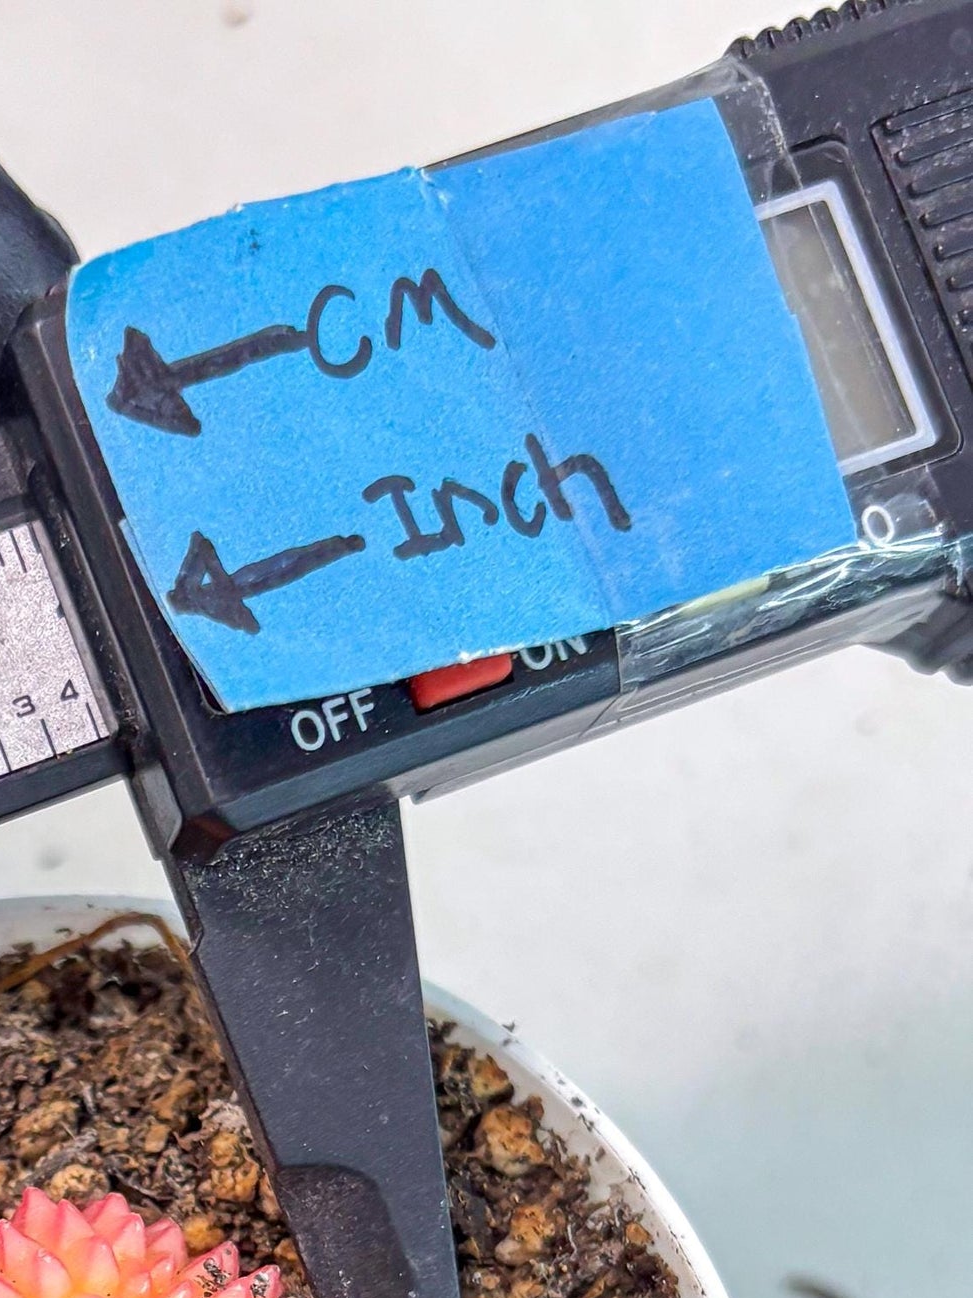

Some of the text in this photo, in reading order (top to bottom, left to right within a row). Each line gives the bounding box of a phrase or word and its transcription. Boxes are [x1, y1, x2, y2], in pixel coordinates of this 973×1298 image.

[362, 432, 631, 560] Inch
[12, 695, 35, 717] 3
[60, 679, 79, 702] 4
[291, 687, 375, 751] OFF
